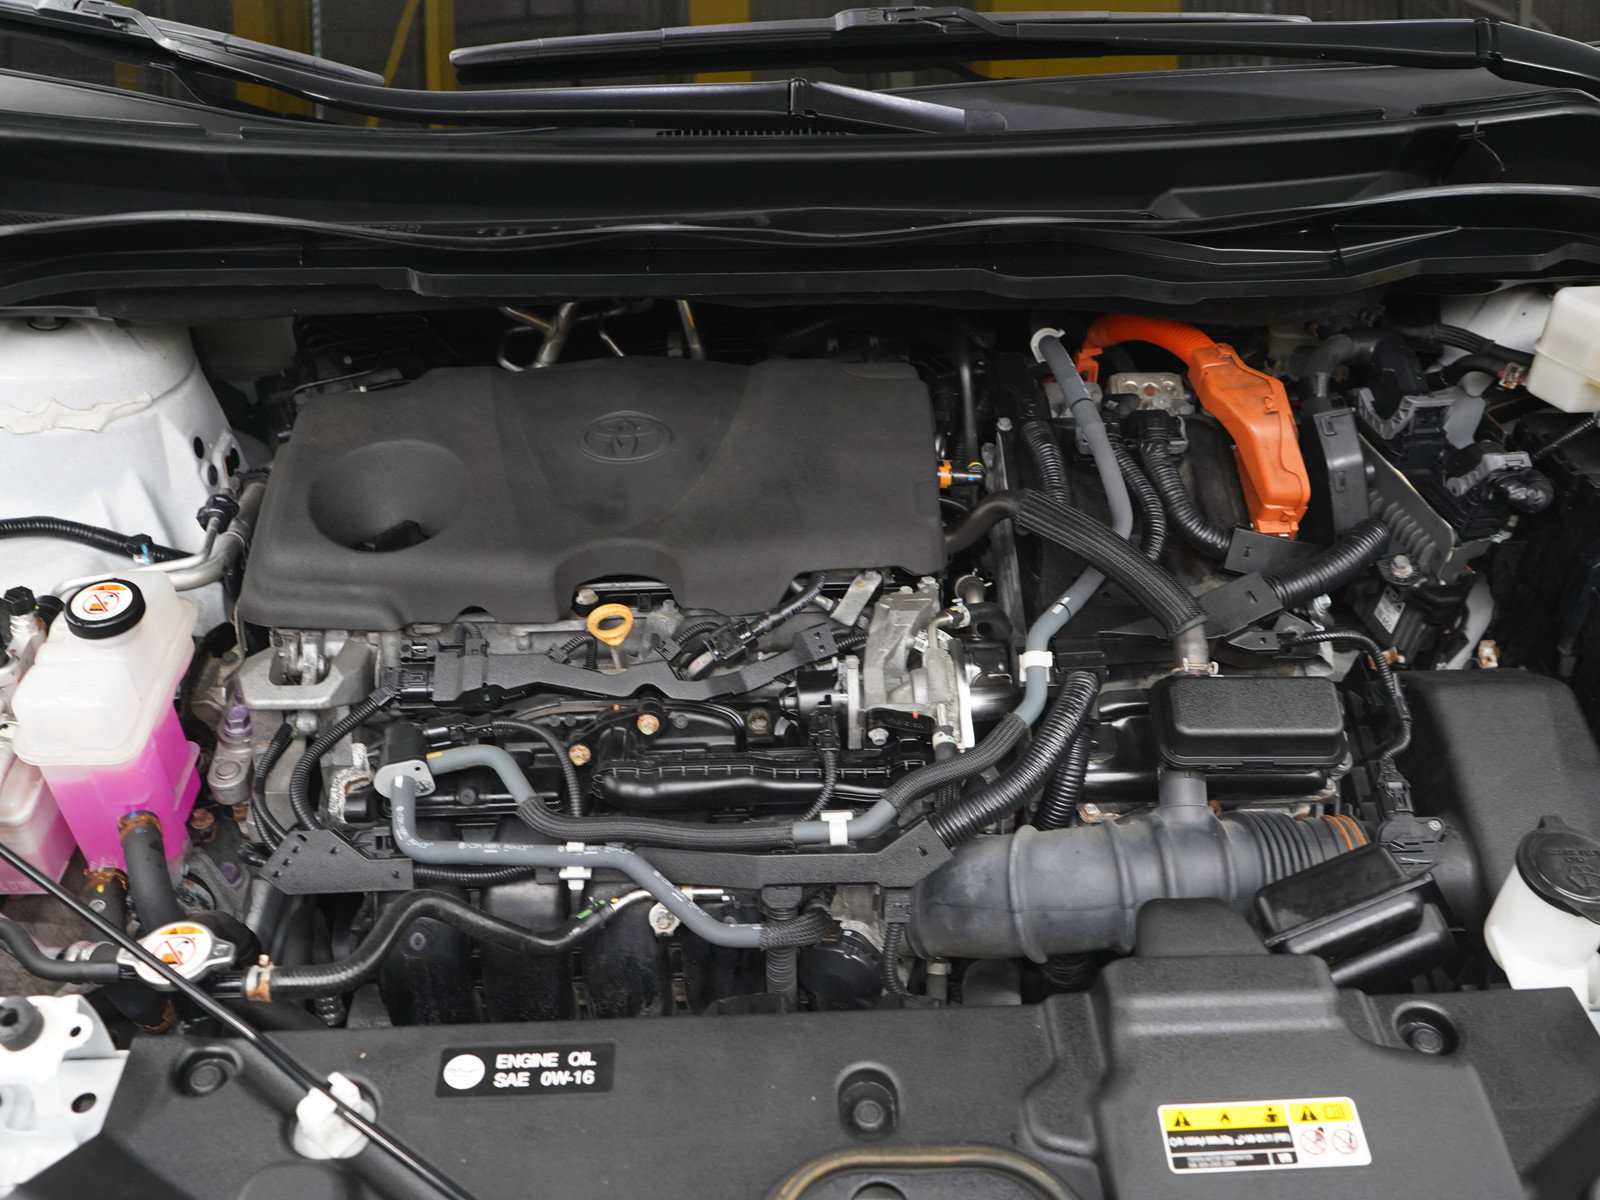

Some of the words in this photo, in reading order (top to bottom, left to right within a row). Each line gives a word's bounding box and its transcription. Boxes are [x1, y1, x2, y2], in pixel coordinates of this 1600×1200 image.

[495, 1052, 559, 1069] ENGINE
[567, 1051, 597, 1067] OIL
[493, 1071, 531, 1088] SAE
[540, 1069, 595, 1087] 0W-16
